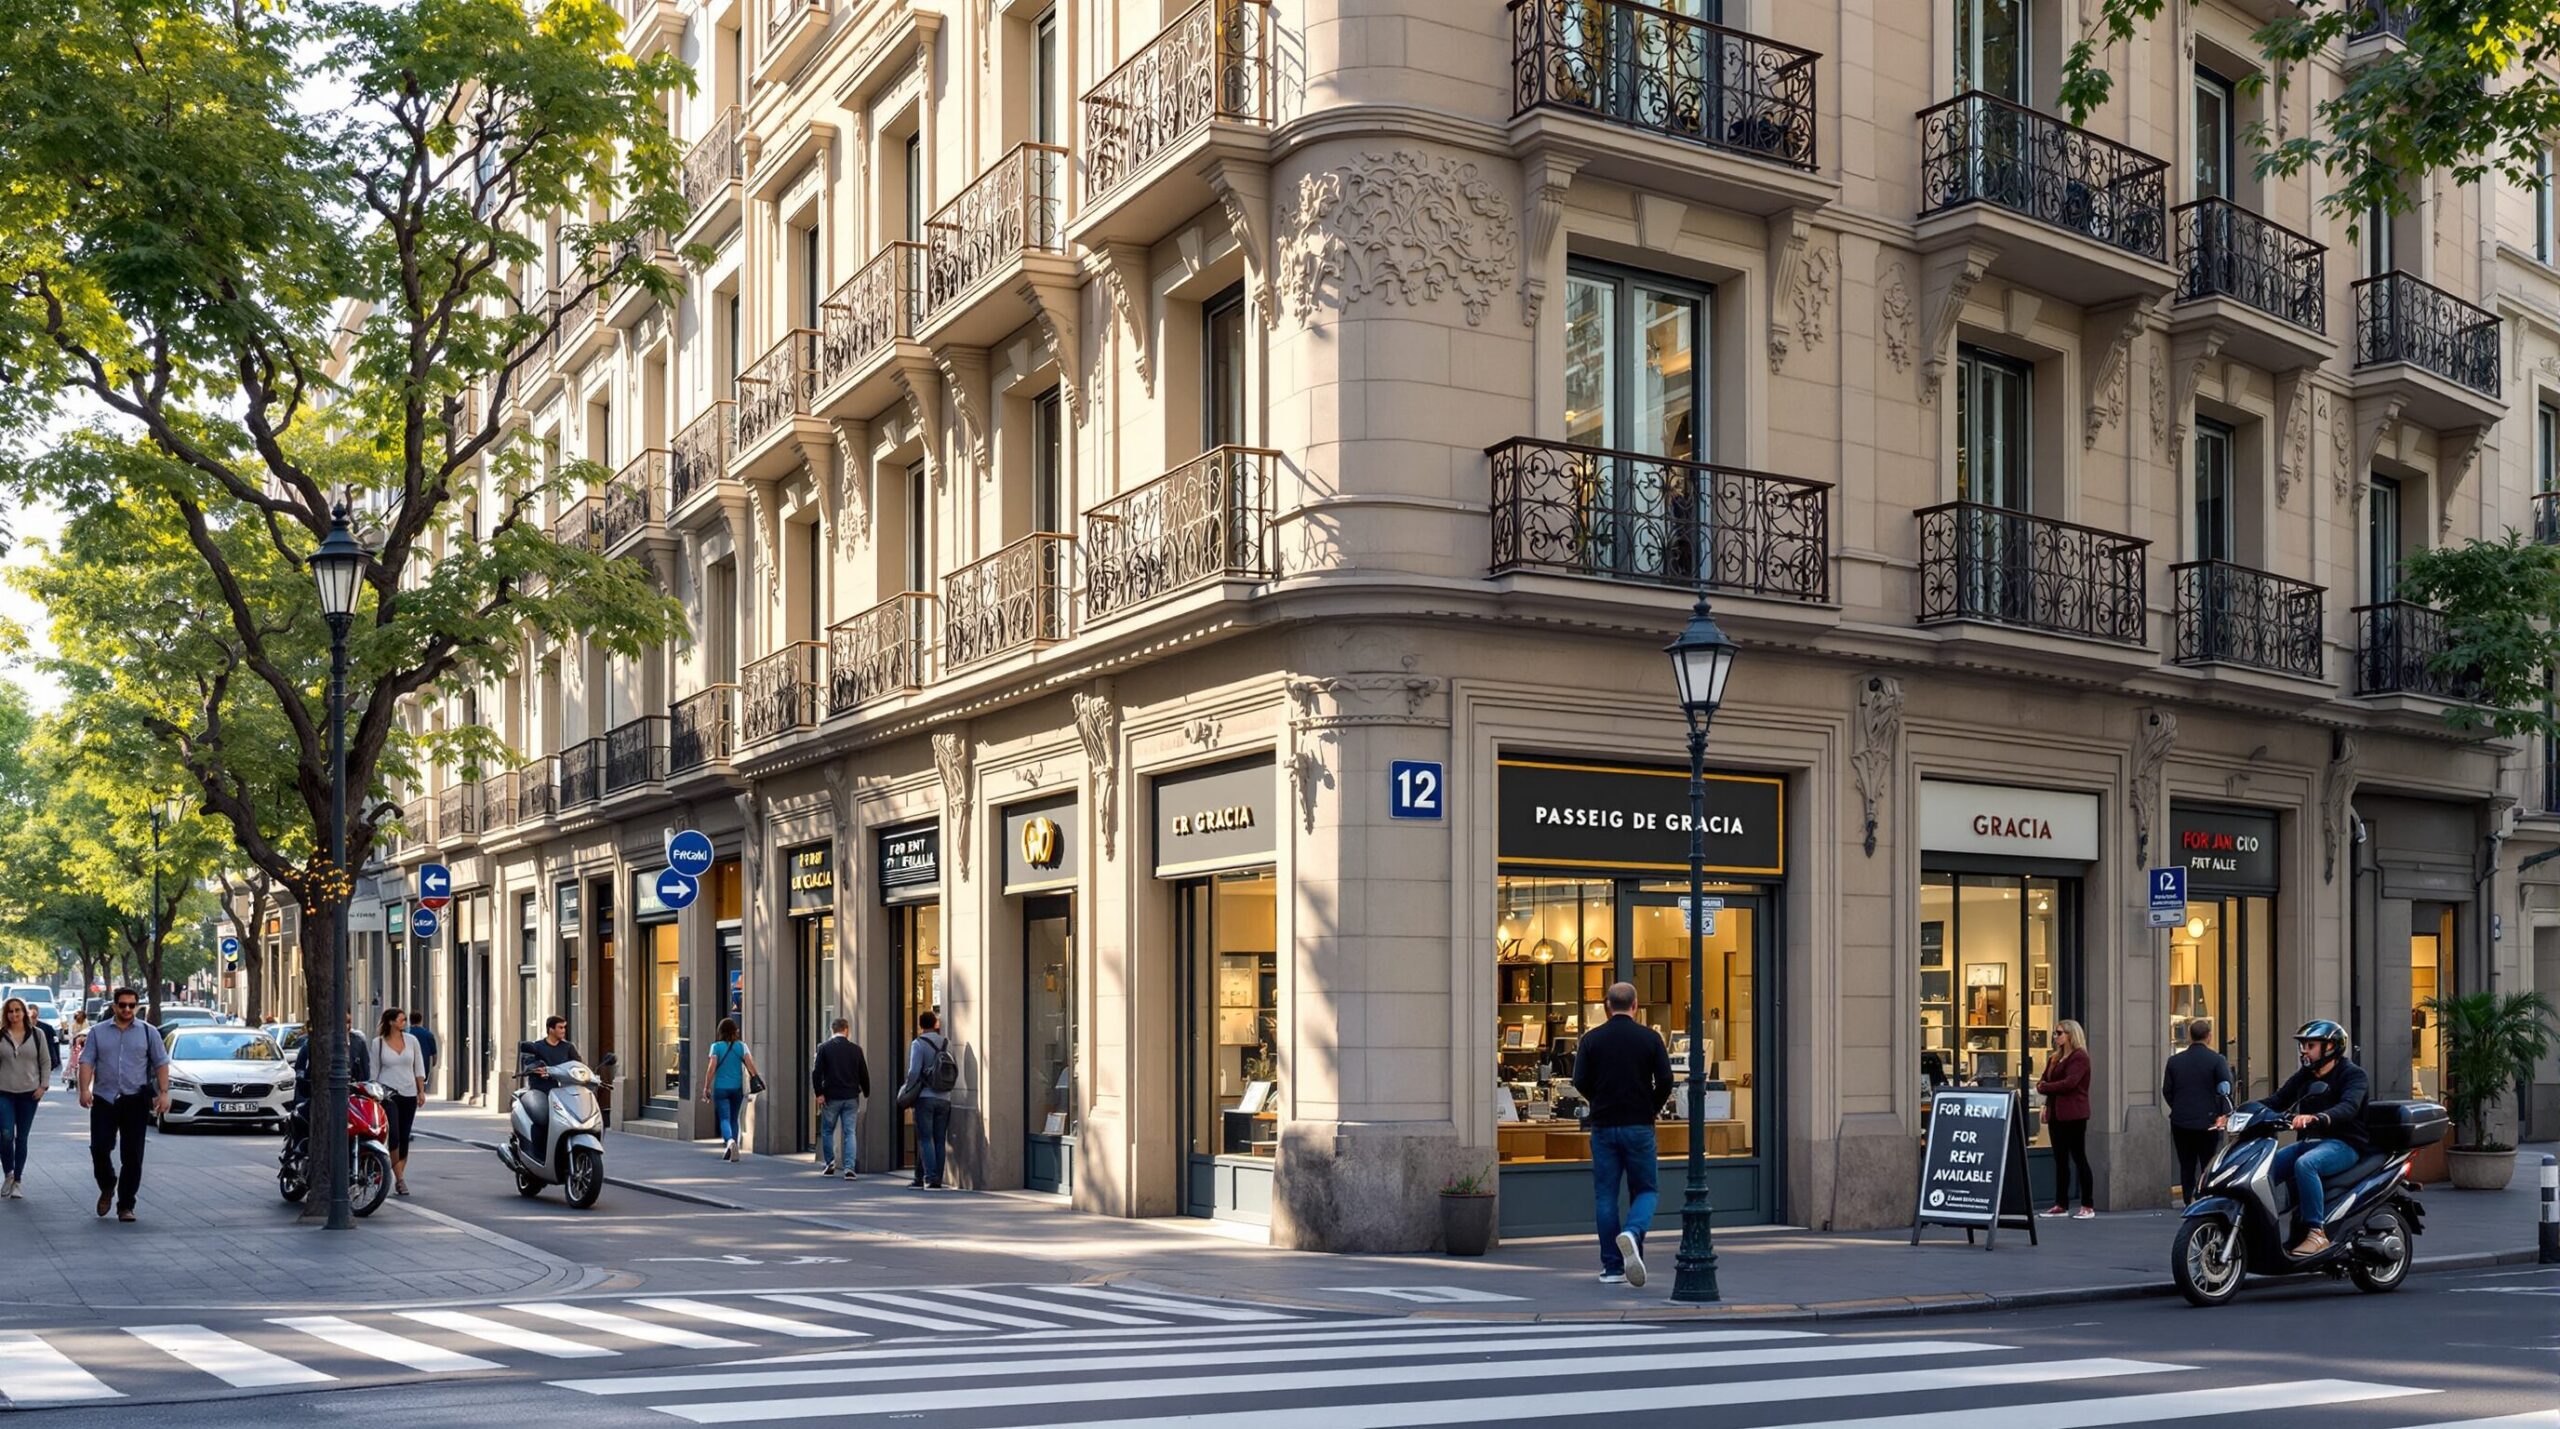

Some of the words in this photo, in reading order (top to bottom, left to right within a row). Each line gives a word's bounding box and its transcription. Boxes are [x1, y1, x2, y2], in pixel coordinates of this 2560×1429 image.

[1397, 768, 1437, 809] 12
[1194, 805, 1250, 832] GRACIA
[1535, 806, 1624, 829] PASSEIG
[1633, 812, 1657, 830] DE
[1665, 813, 1744, 835] GRACIA
[1973, 814, 2053, 840] GRACIA
[1939, 1103, 1961, 1117] FOR
[1964, 1103, 1999, 1120] RENT
[1952, 1130, 1978, 1144] FOR
[1949, 1150, 1985, 1165] RENT
